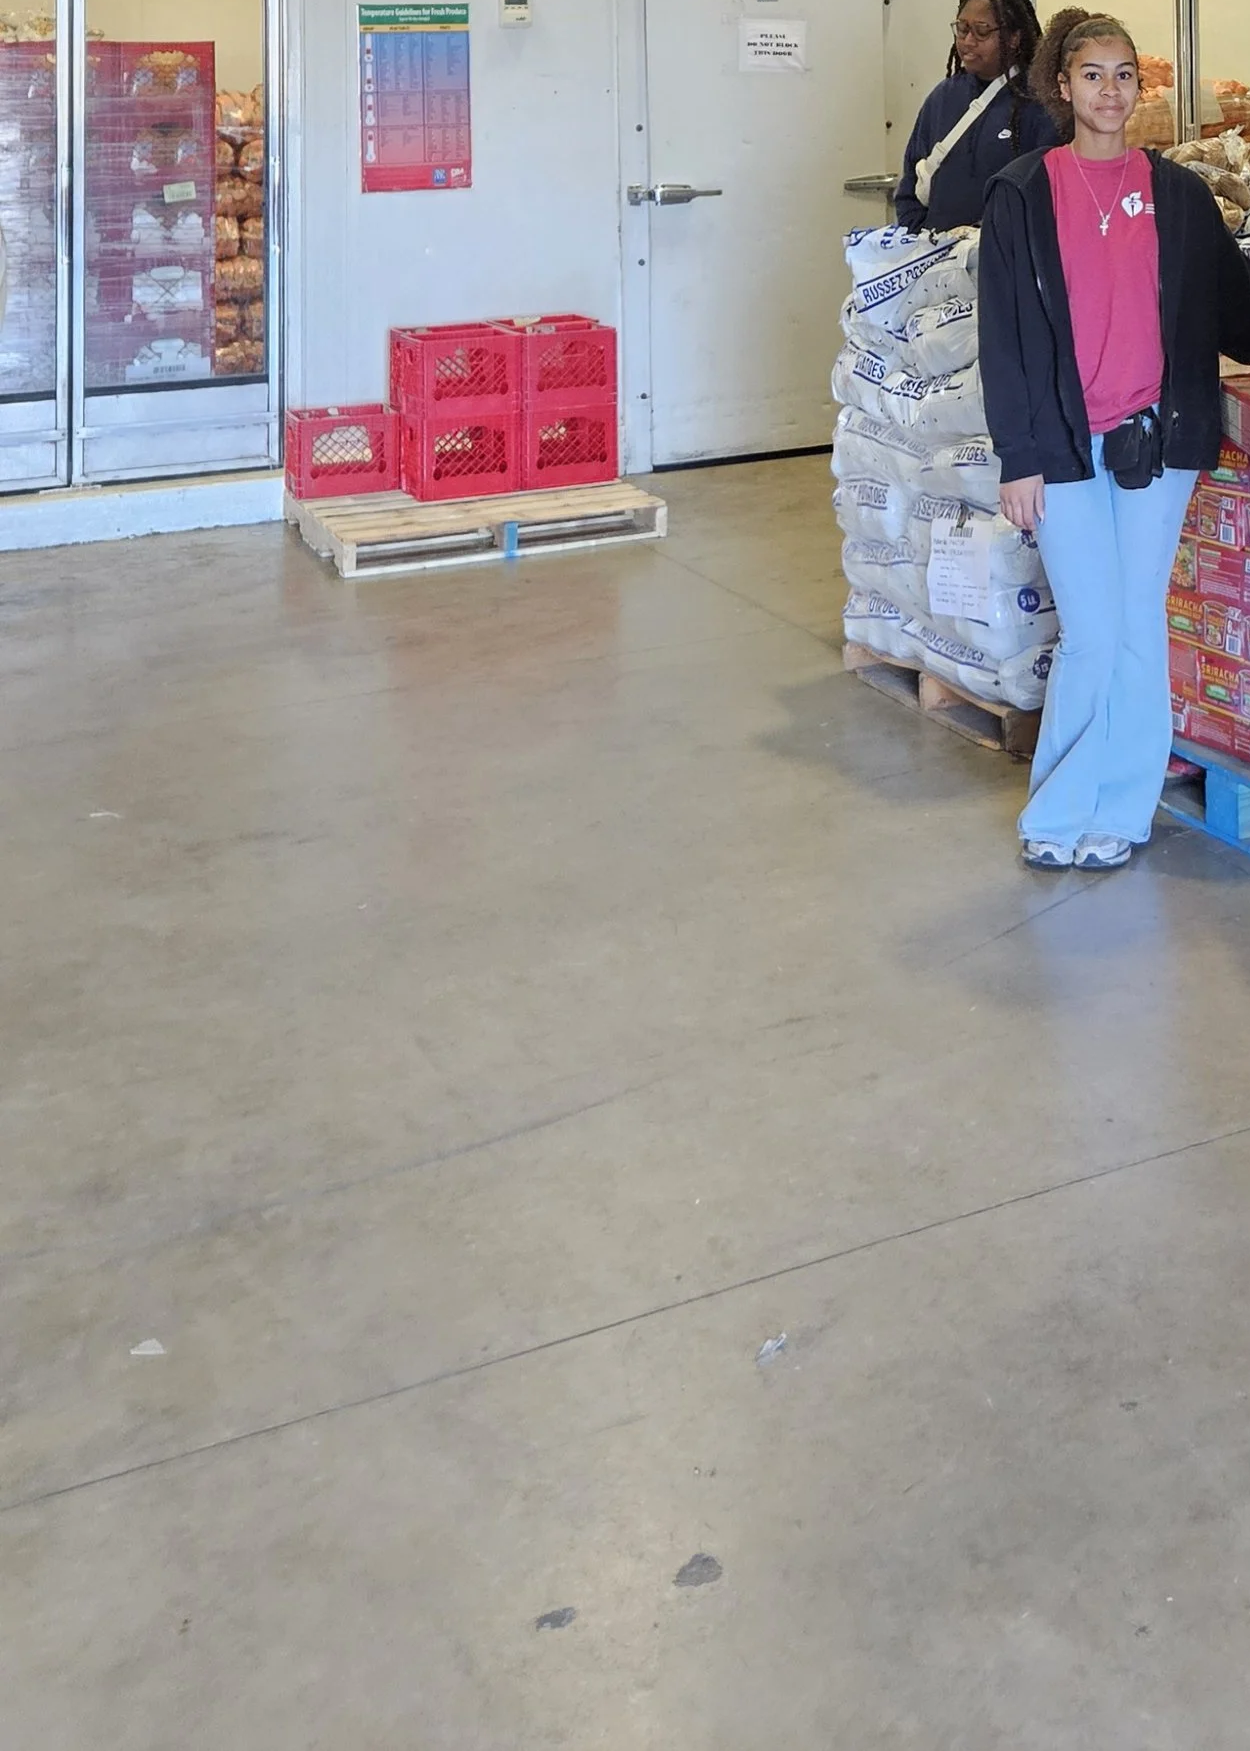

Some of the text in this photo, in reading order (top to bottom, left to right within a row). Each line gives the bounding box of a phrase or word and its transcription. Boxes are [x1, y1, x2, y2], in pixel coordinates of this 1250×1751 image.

[361, 7, 467, 18] Temperature Guidelines for Fresh Produce
[1200, 663, 1240, 682] SRIRACHA
